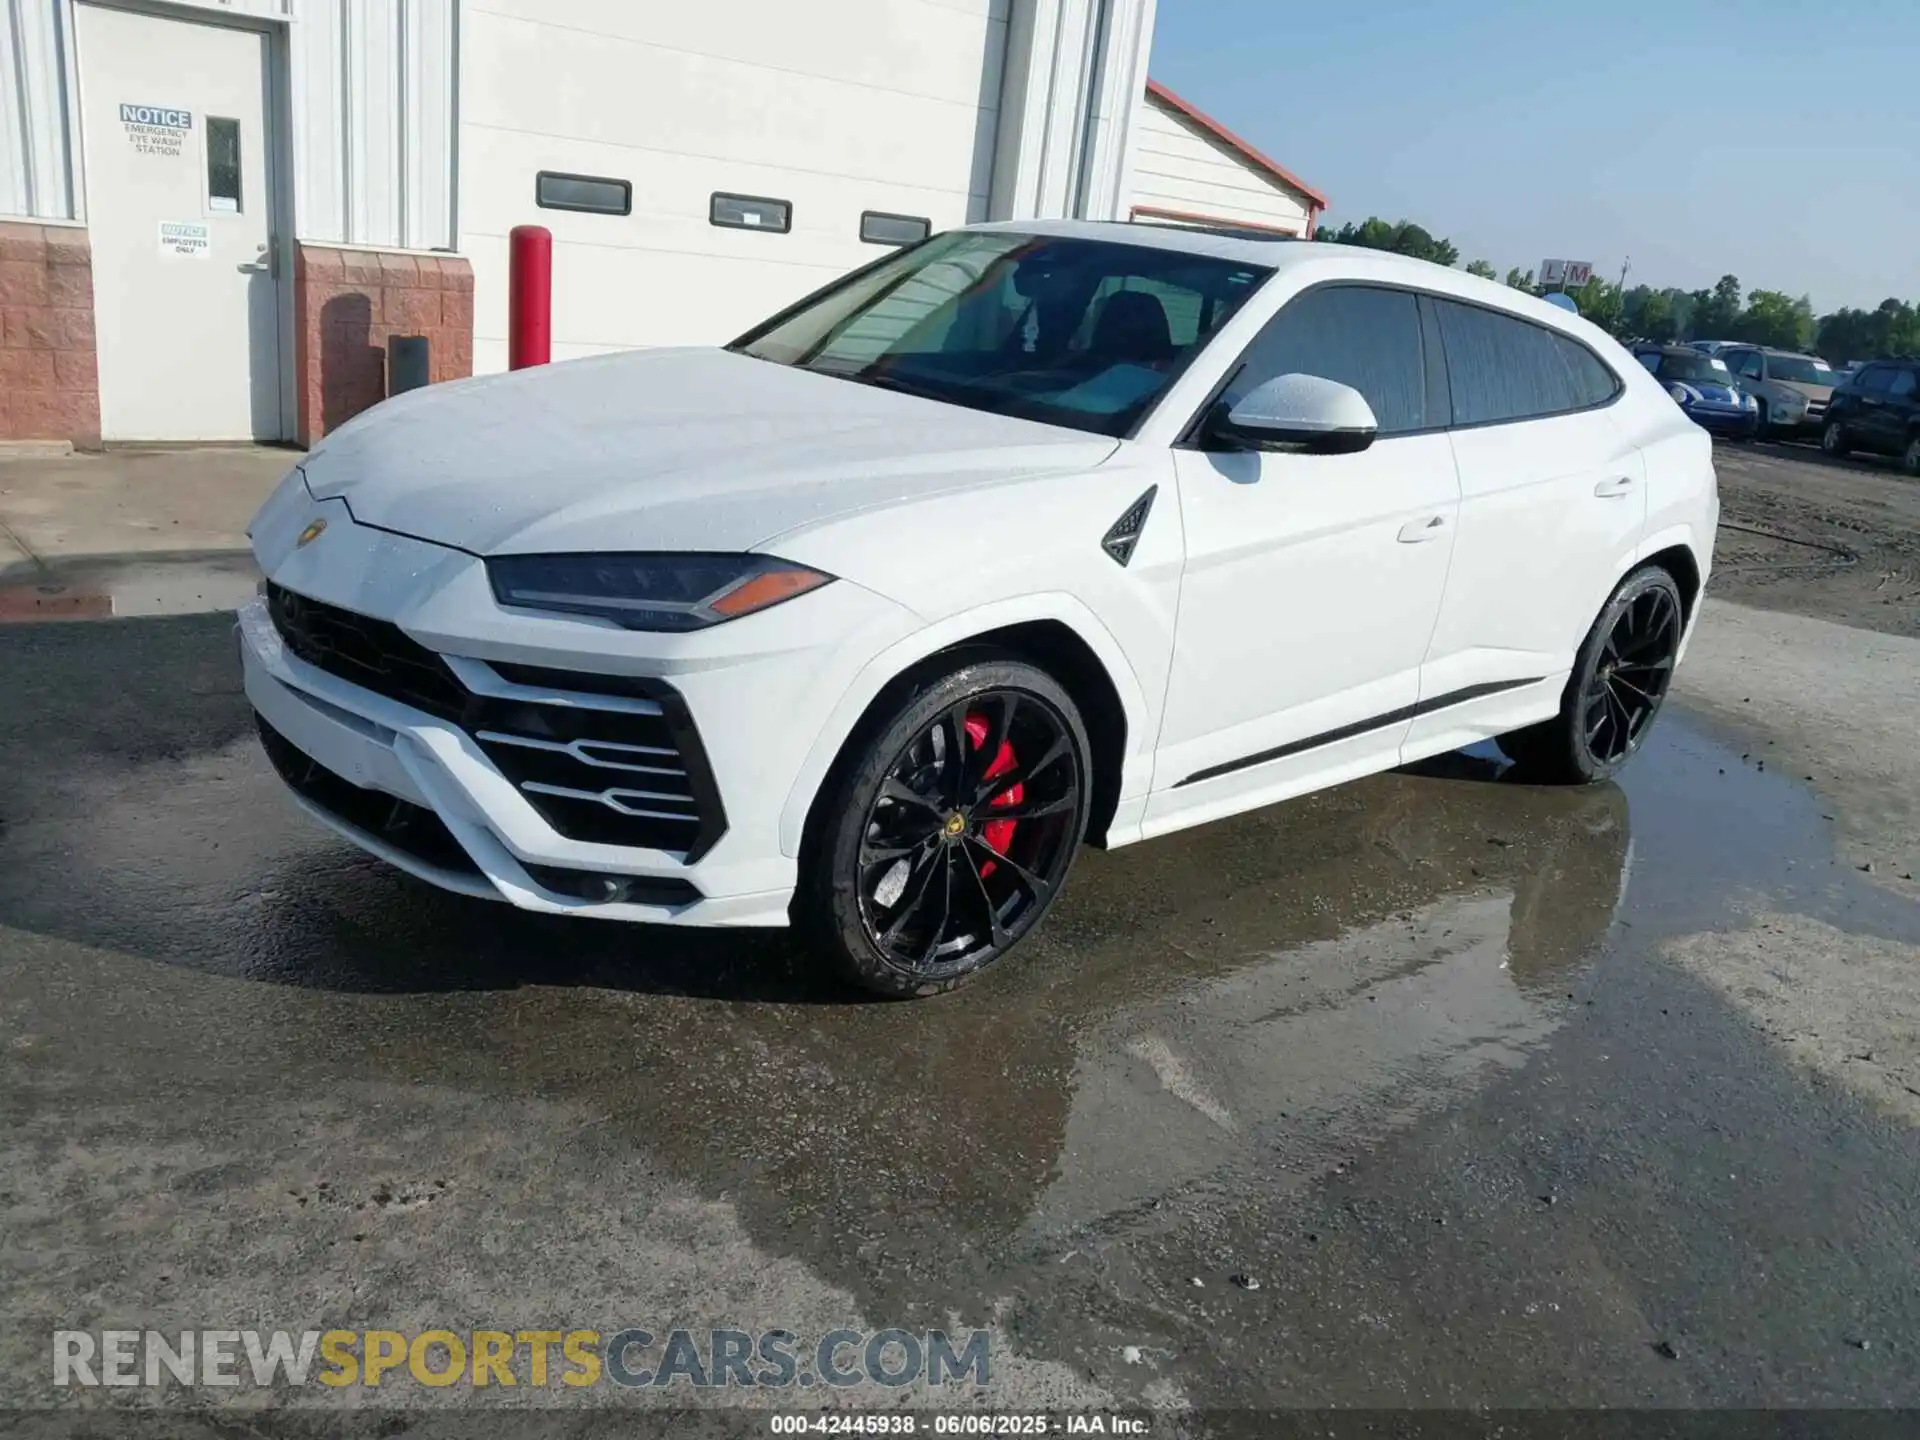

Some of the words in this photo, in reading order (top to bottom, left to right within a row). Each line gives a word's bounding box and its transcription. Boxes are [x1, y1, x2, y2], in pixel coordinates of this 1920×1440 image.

[122, 105, 190, 127] NOTICE
[124, 124, 188, 138] EMERGENCY
[129, 134, 149, 144] EYE
[151, 136, 182, 147] WASH
[135, 144, 180, 156] STATION
[1570, 265, 1590, 283] M
